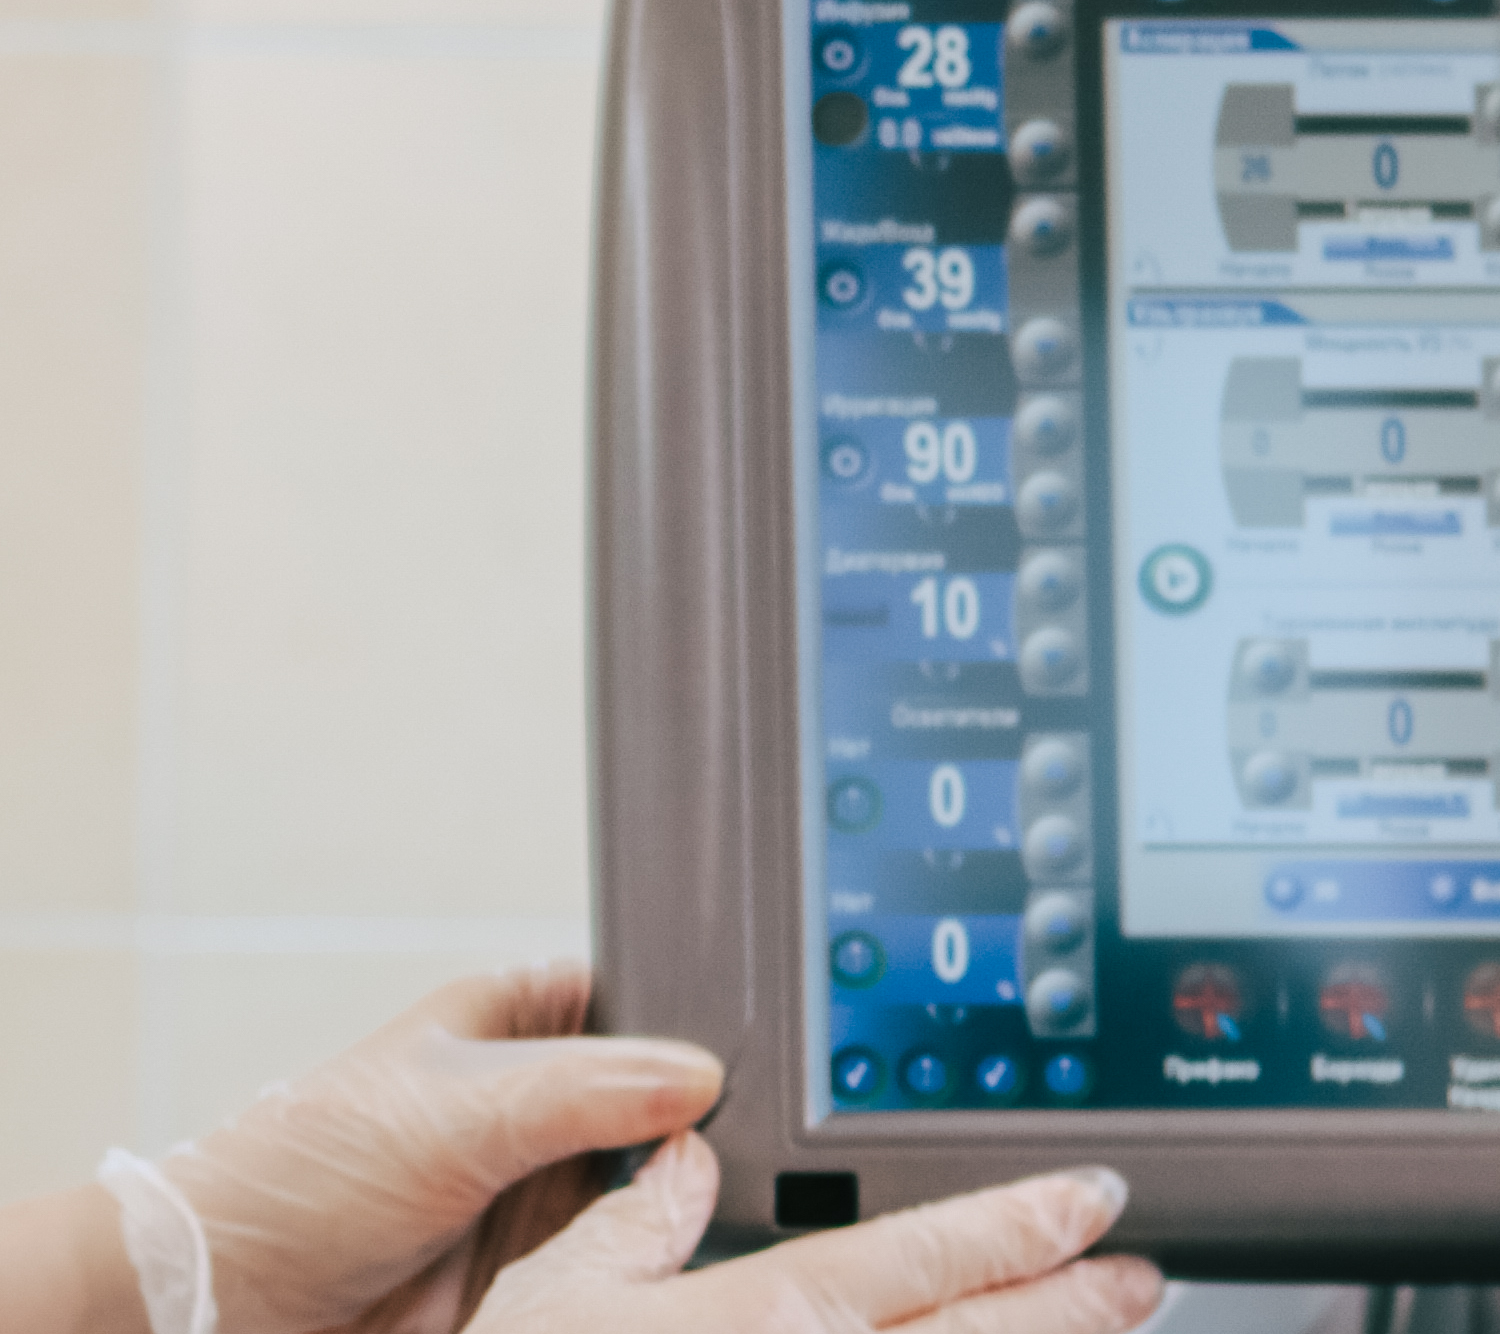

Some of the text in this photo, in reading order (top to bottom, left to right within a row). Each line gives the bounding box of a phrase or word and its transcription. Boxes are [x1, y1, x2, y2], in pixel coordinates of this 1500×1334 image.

[897, 25, 971, 89] 28
[1372, 142, 1399, 190] 0
[903, 246, 975, 310] 39
[904, 420, 976, 484] 90
[1381, 417, 1407, 464] 0
[911, 577, 979, 639] 10
[1388, 700, 1414, 746] 0
[930, 765, 965, 828] 0
[933, 917, 969, 983] 0
